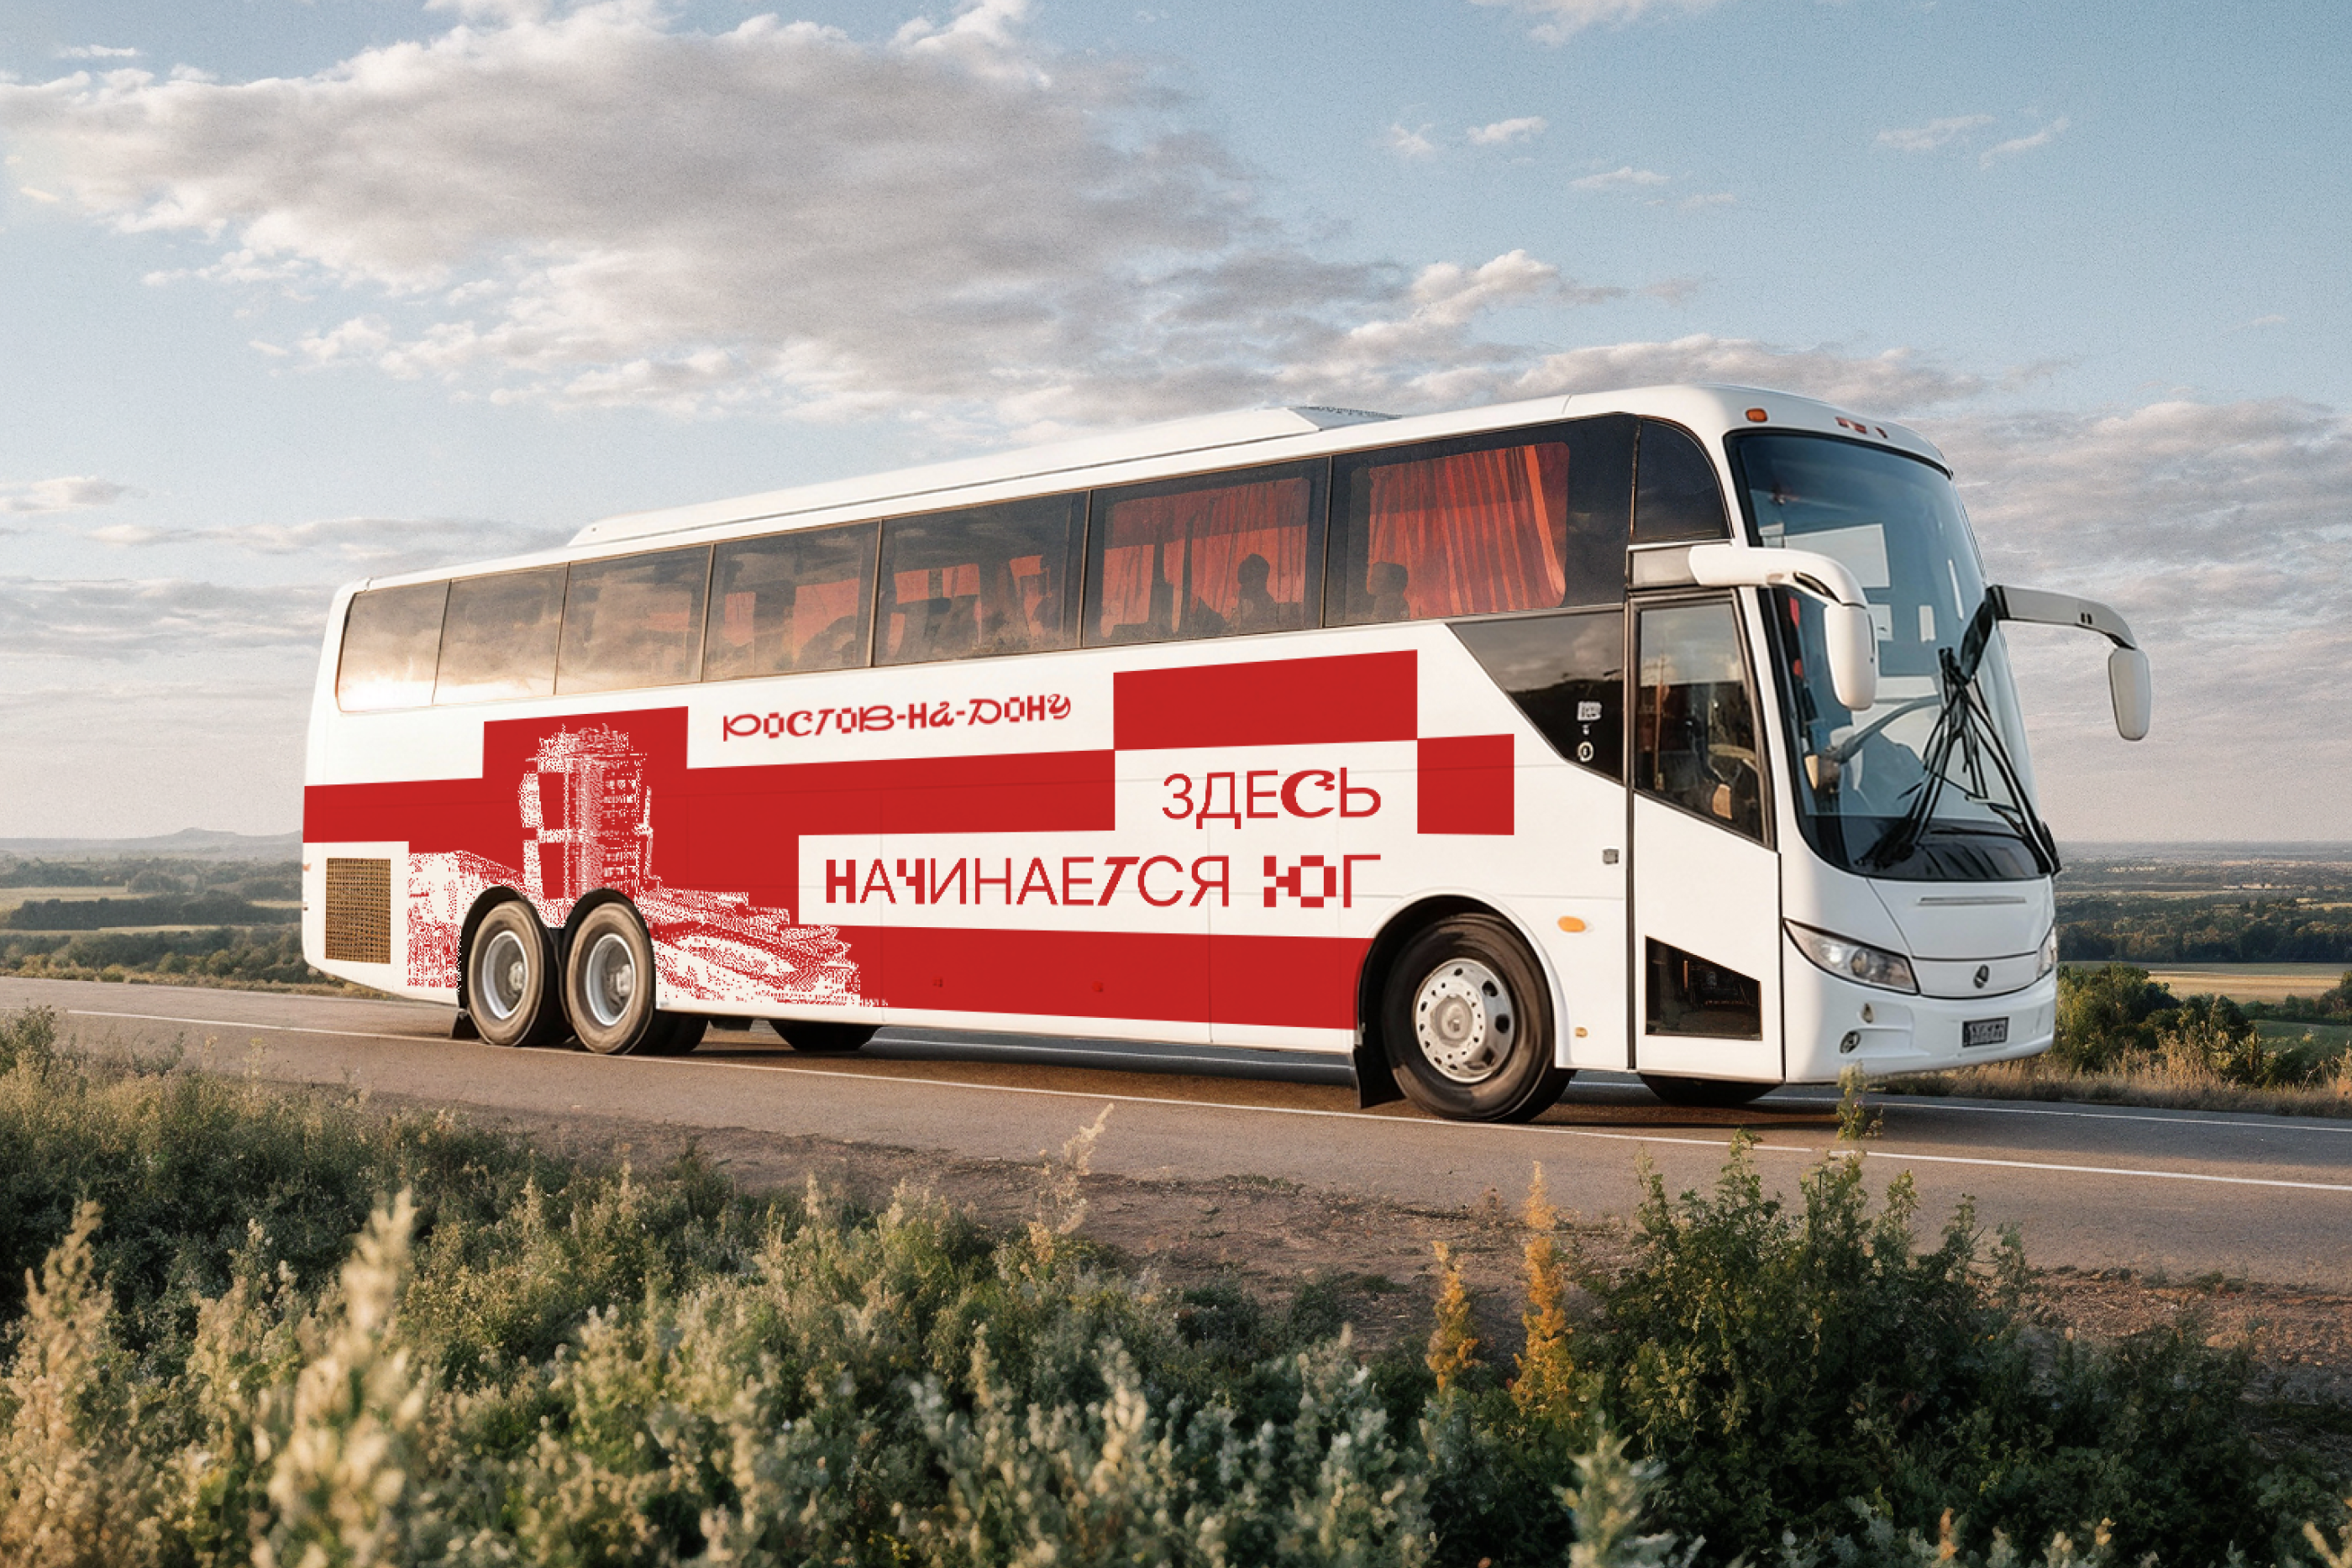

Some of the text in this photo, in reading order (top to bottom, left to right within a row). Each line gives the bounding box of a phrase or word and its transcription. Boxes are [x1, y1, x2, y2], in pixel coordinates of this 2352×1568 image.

[1163, 768, 1381, 829] ЗДЕСЬ
[826, 855, 1381, 908] НАЧИНАЕТСЯ ЮГ
